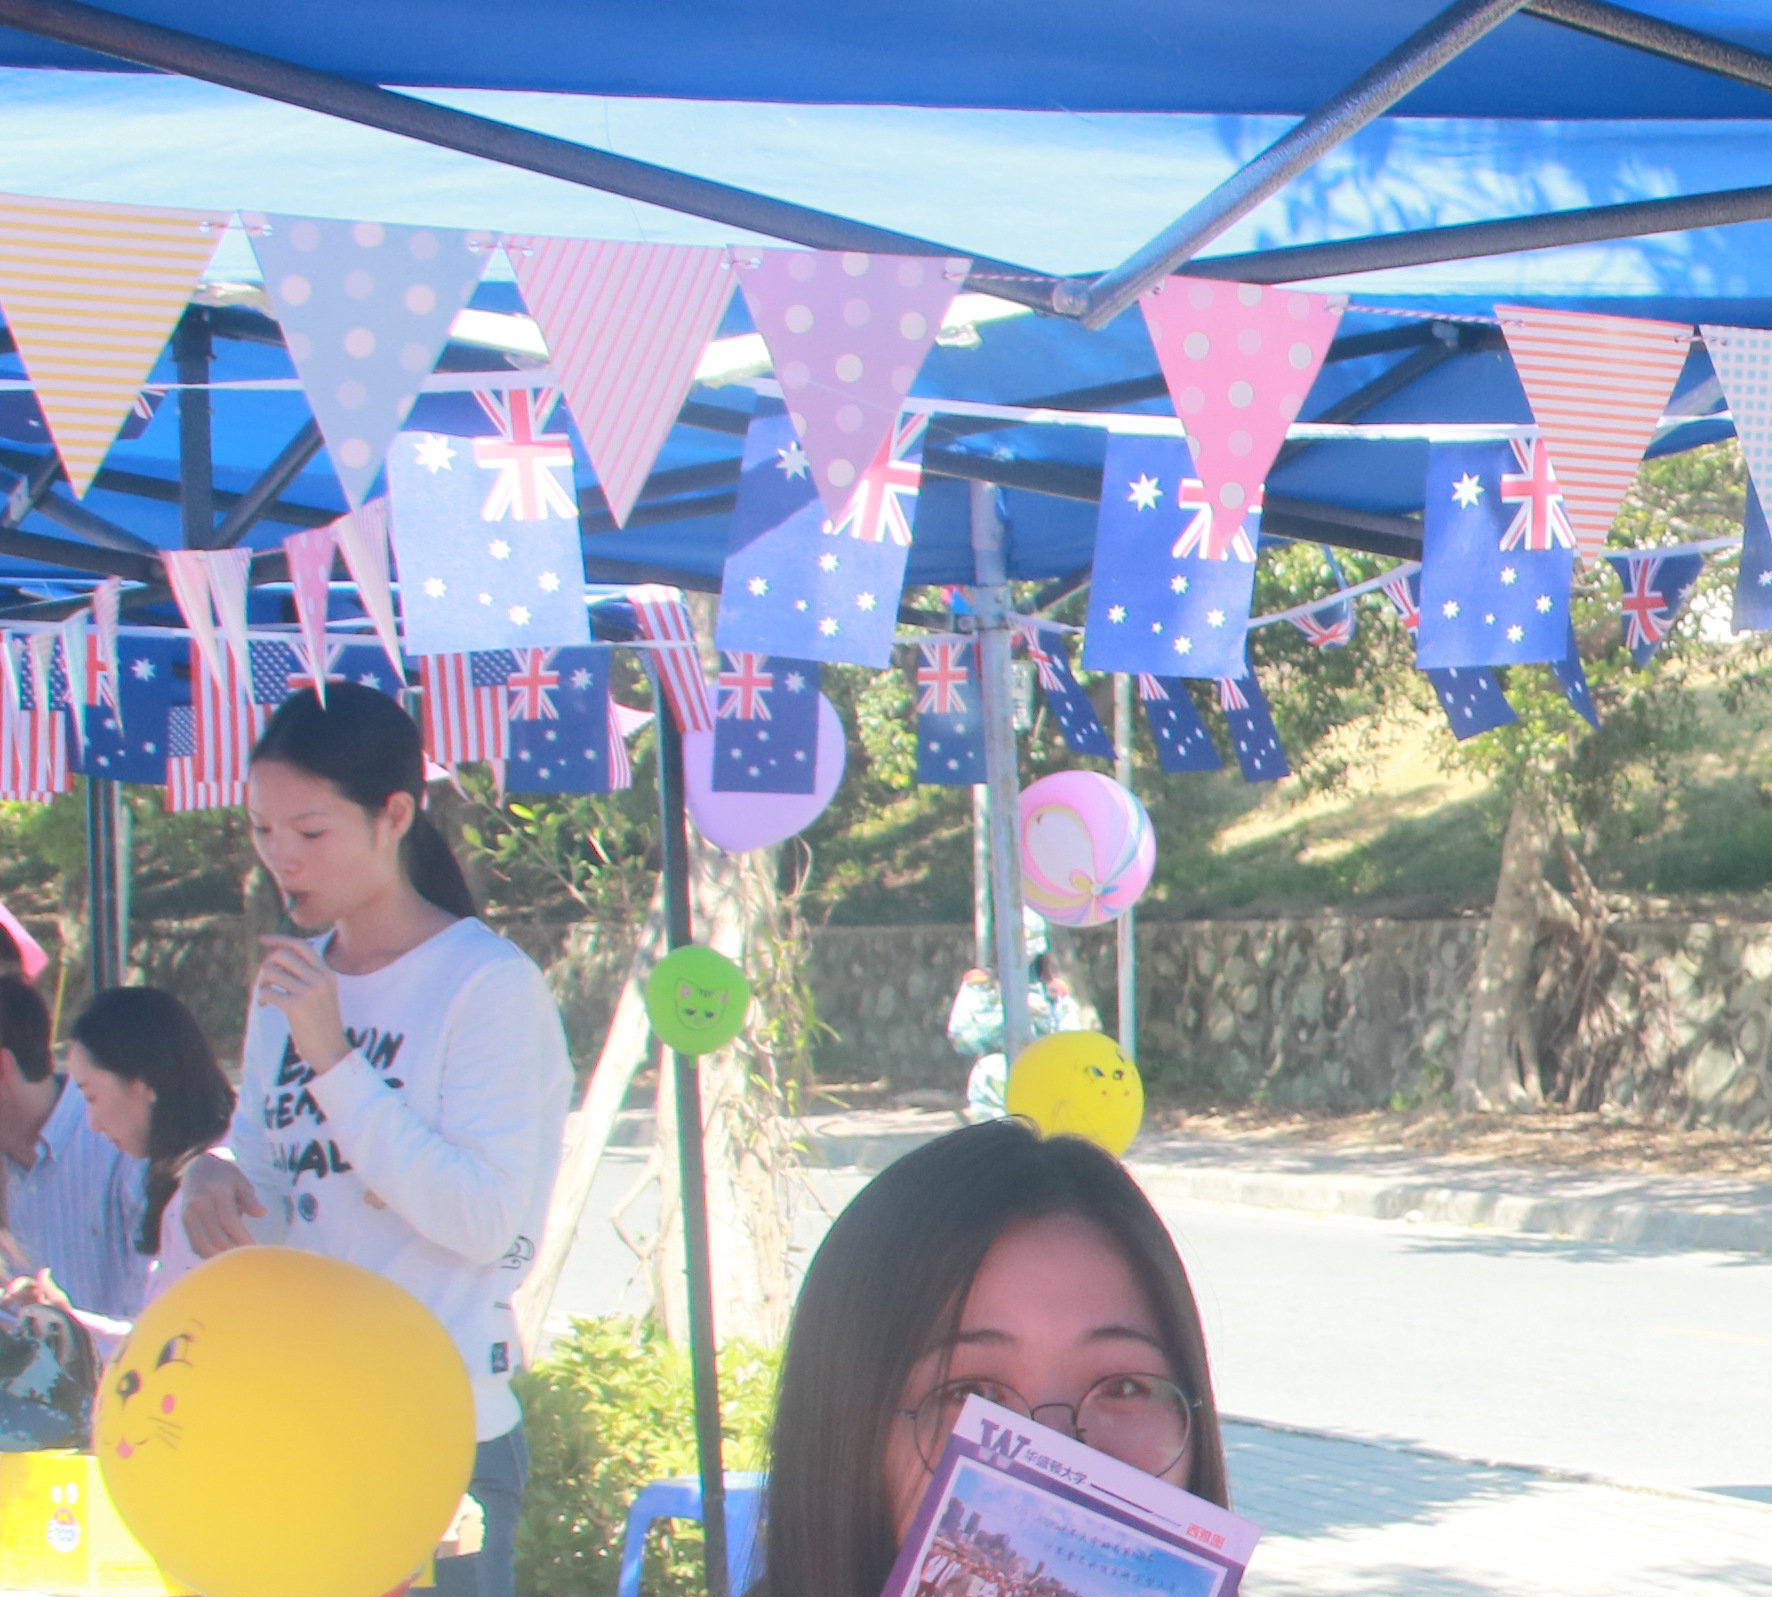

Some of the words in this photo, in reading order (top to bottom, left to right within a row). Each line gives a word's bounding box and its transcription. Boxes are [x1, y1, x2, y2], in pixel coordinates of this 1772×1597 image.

[975, 1417, 1032, 1471] W
[1023, 1448, 1088, 1487] 华盛顿大学
